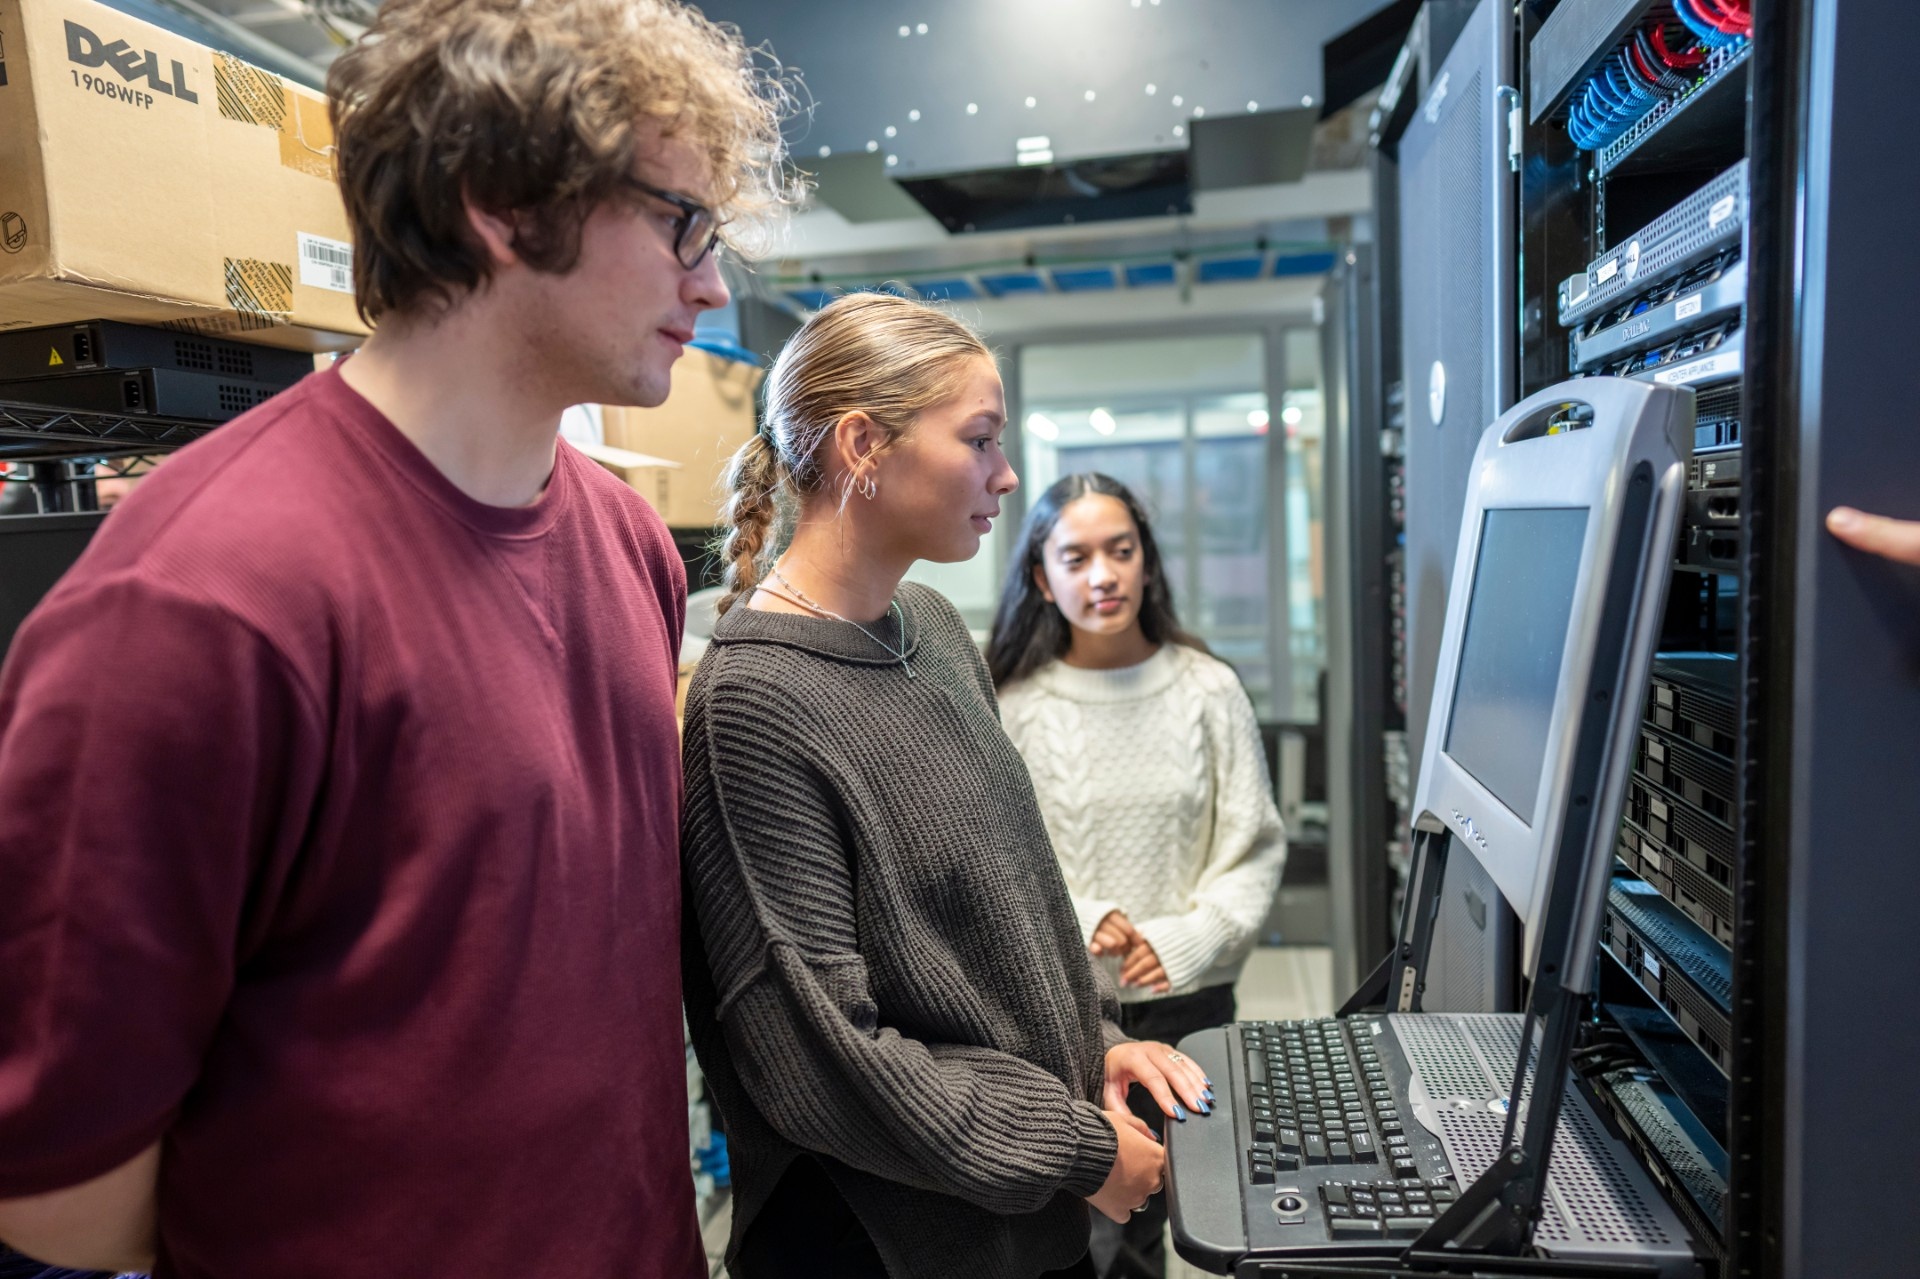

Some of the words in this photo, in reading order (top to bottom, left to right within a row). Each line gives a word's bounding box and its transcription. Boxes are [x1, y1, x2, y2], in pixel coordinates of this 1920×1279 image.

[63, 18, 199, 105] DELL
[229, 60, 257, 93] PACKAGE
[71, 69, 154, 110] 1908WFP
[220, 65, 244, 94] SIGNING
[241, 93, 264, 122] RECEIPT
[230, 69, 260, 107] CONTENTS
[242, 67, 258, 85] SEAL
[260, 92, 284, 121] BROKEN
[250, 259, 277, 292] CONTENTS
[250, 280, 265, 297] SEAL
[251, 271, 276, 301] PACKAGE
[265, 269, 286, 294] SIGNING
[262, 296, 275, 310] THIS
